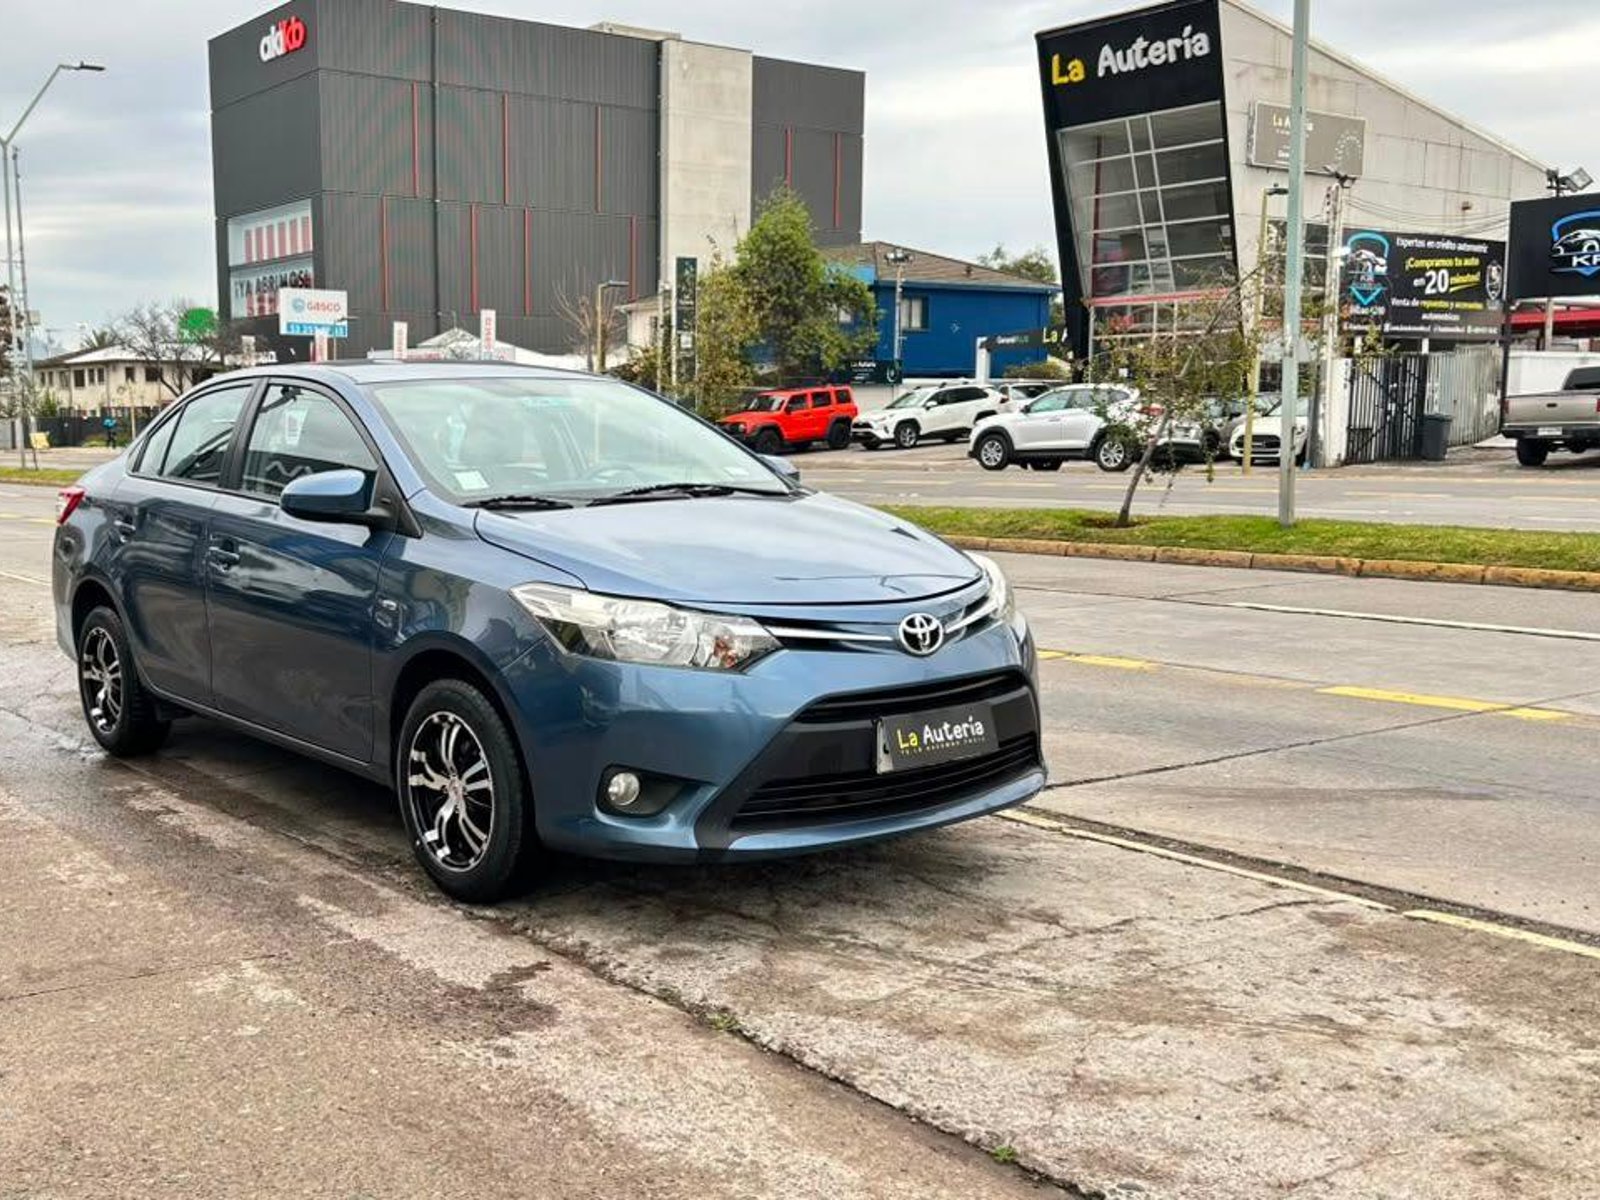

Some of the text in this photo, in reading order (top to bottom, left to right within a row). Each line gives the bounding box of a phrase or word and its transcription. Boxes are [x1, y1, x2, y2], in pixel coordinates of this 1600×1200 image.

[1052, 24, 1211, 85] La Autería
[1425, 269, 1449, 295] 20
[1043, 328, 1058, 344] La
[896, 729, 918, 749] La
[923, 714, 985, 746] Autería
